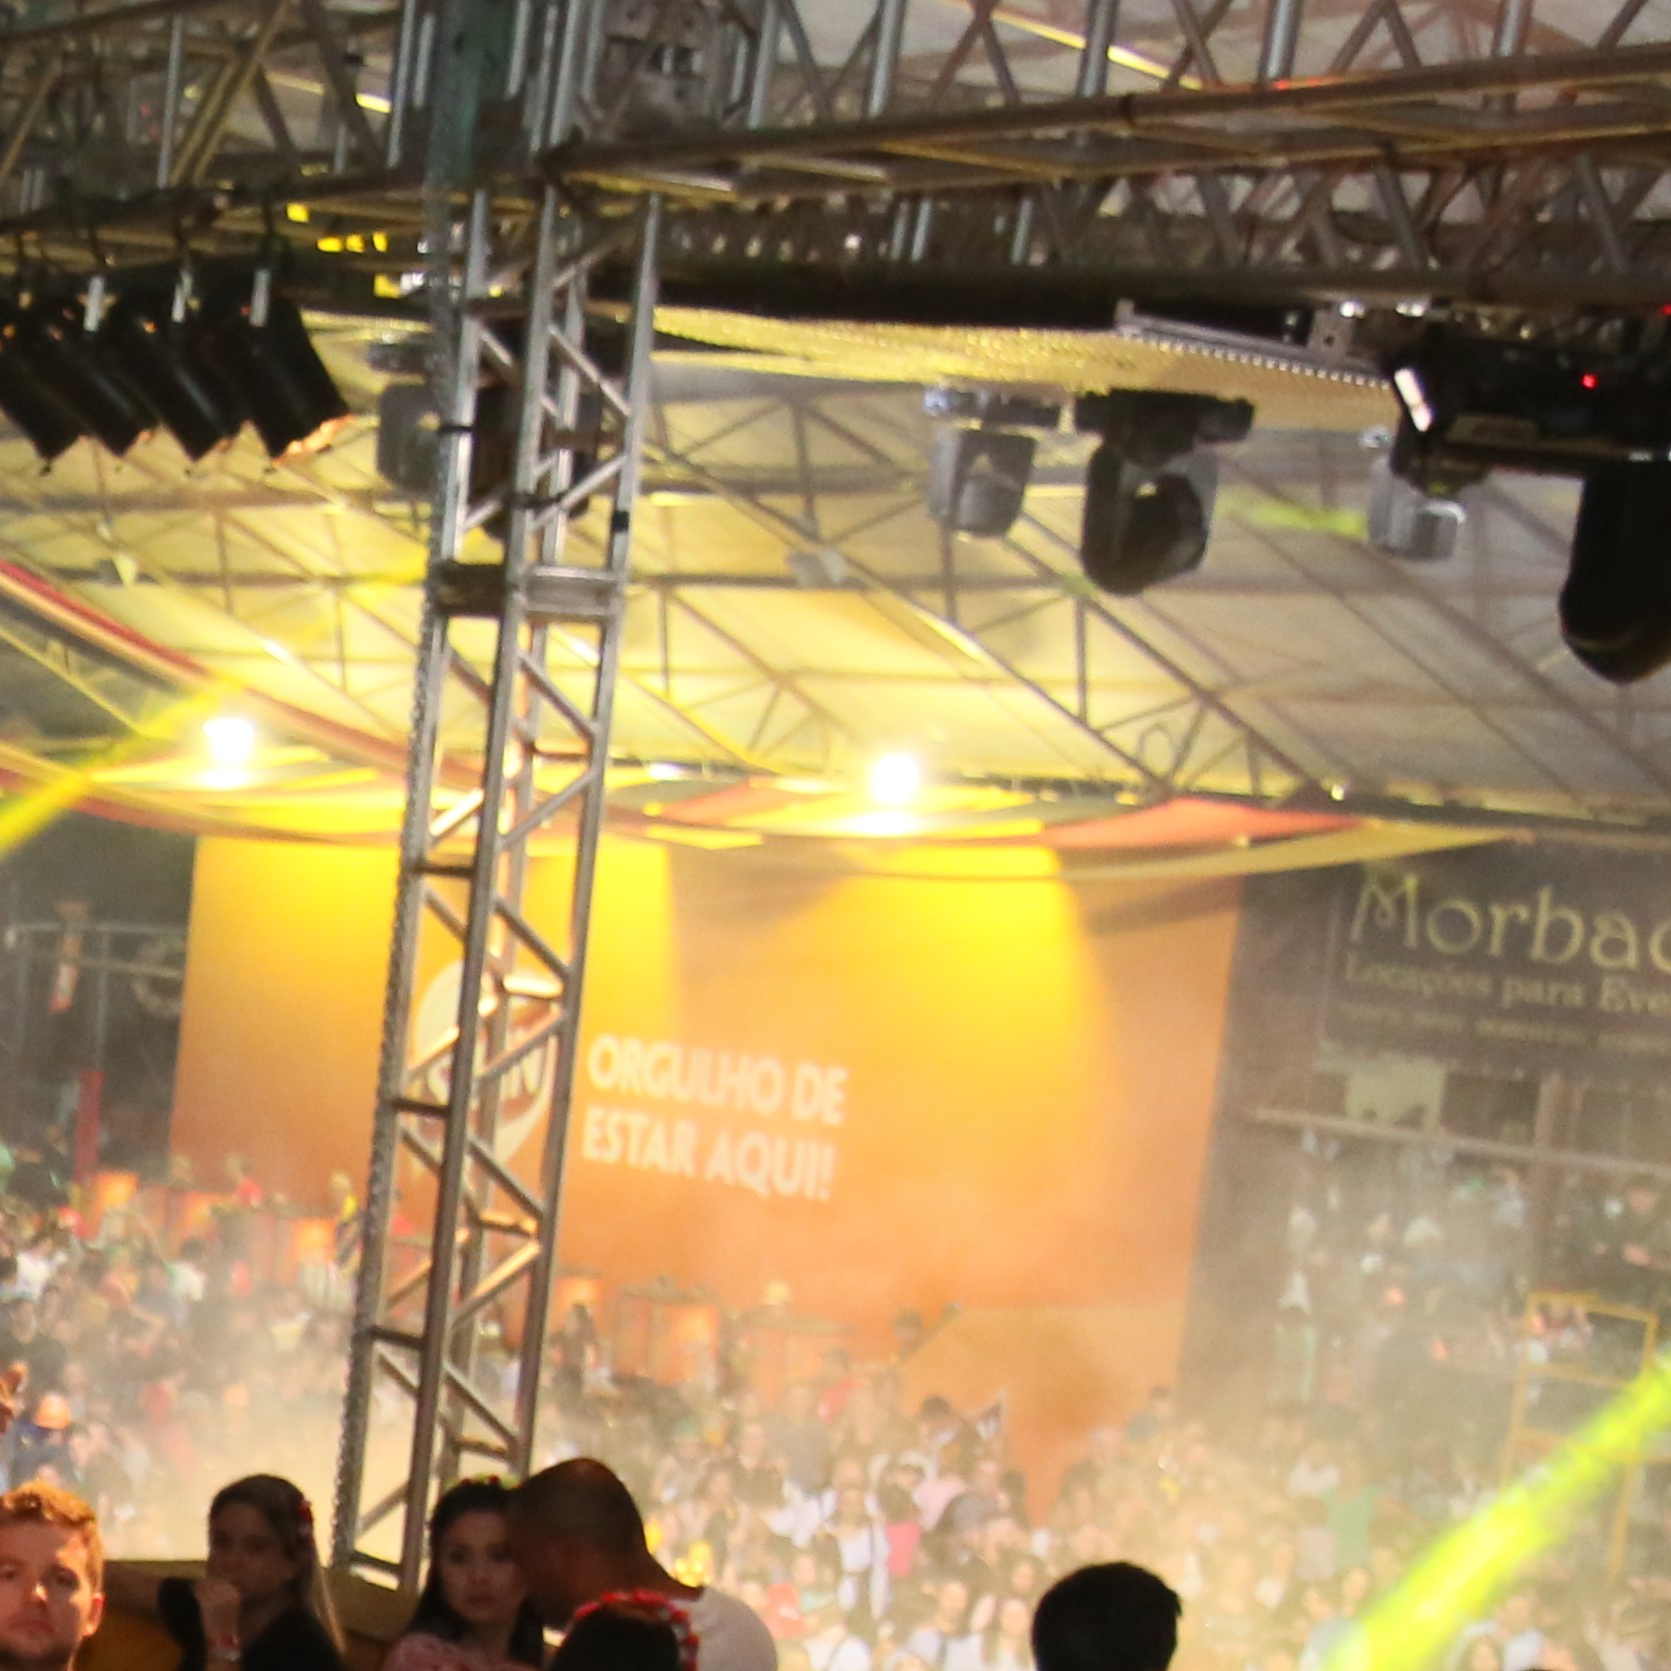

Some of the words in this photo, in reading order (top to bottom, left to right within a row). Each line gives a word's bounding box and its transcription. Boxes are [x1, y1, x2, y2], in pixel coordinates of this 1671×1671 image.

[1504, 976, 1586, 1010] para
[586, 1033, 786, 1116] ORGULHO
[790, 1055, 850, 1127] DE
[582, 1104, 696, 1181] ESTAR
[704, 1125, 836, 1203] AQUI!
